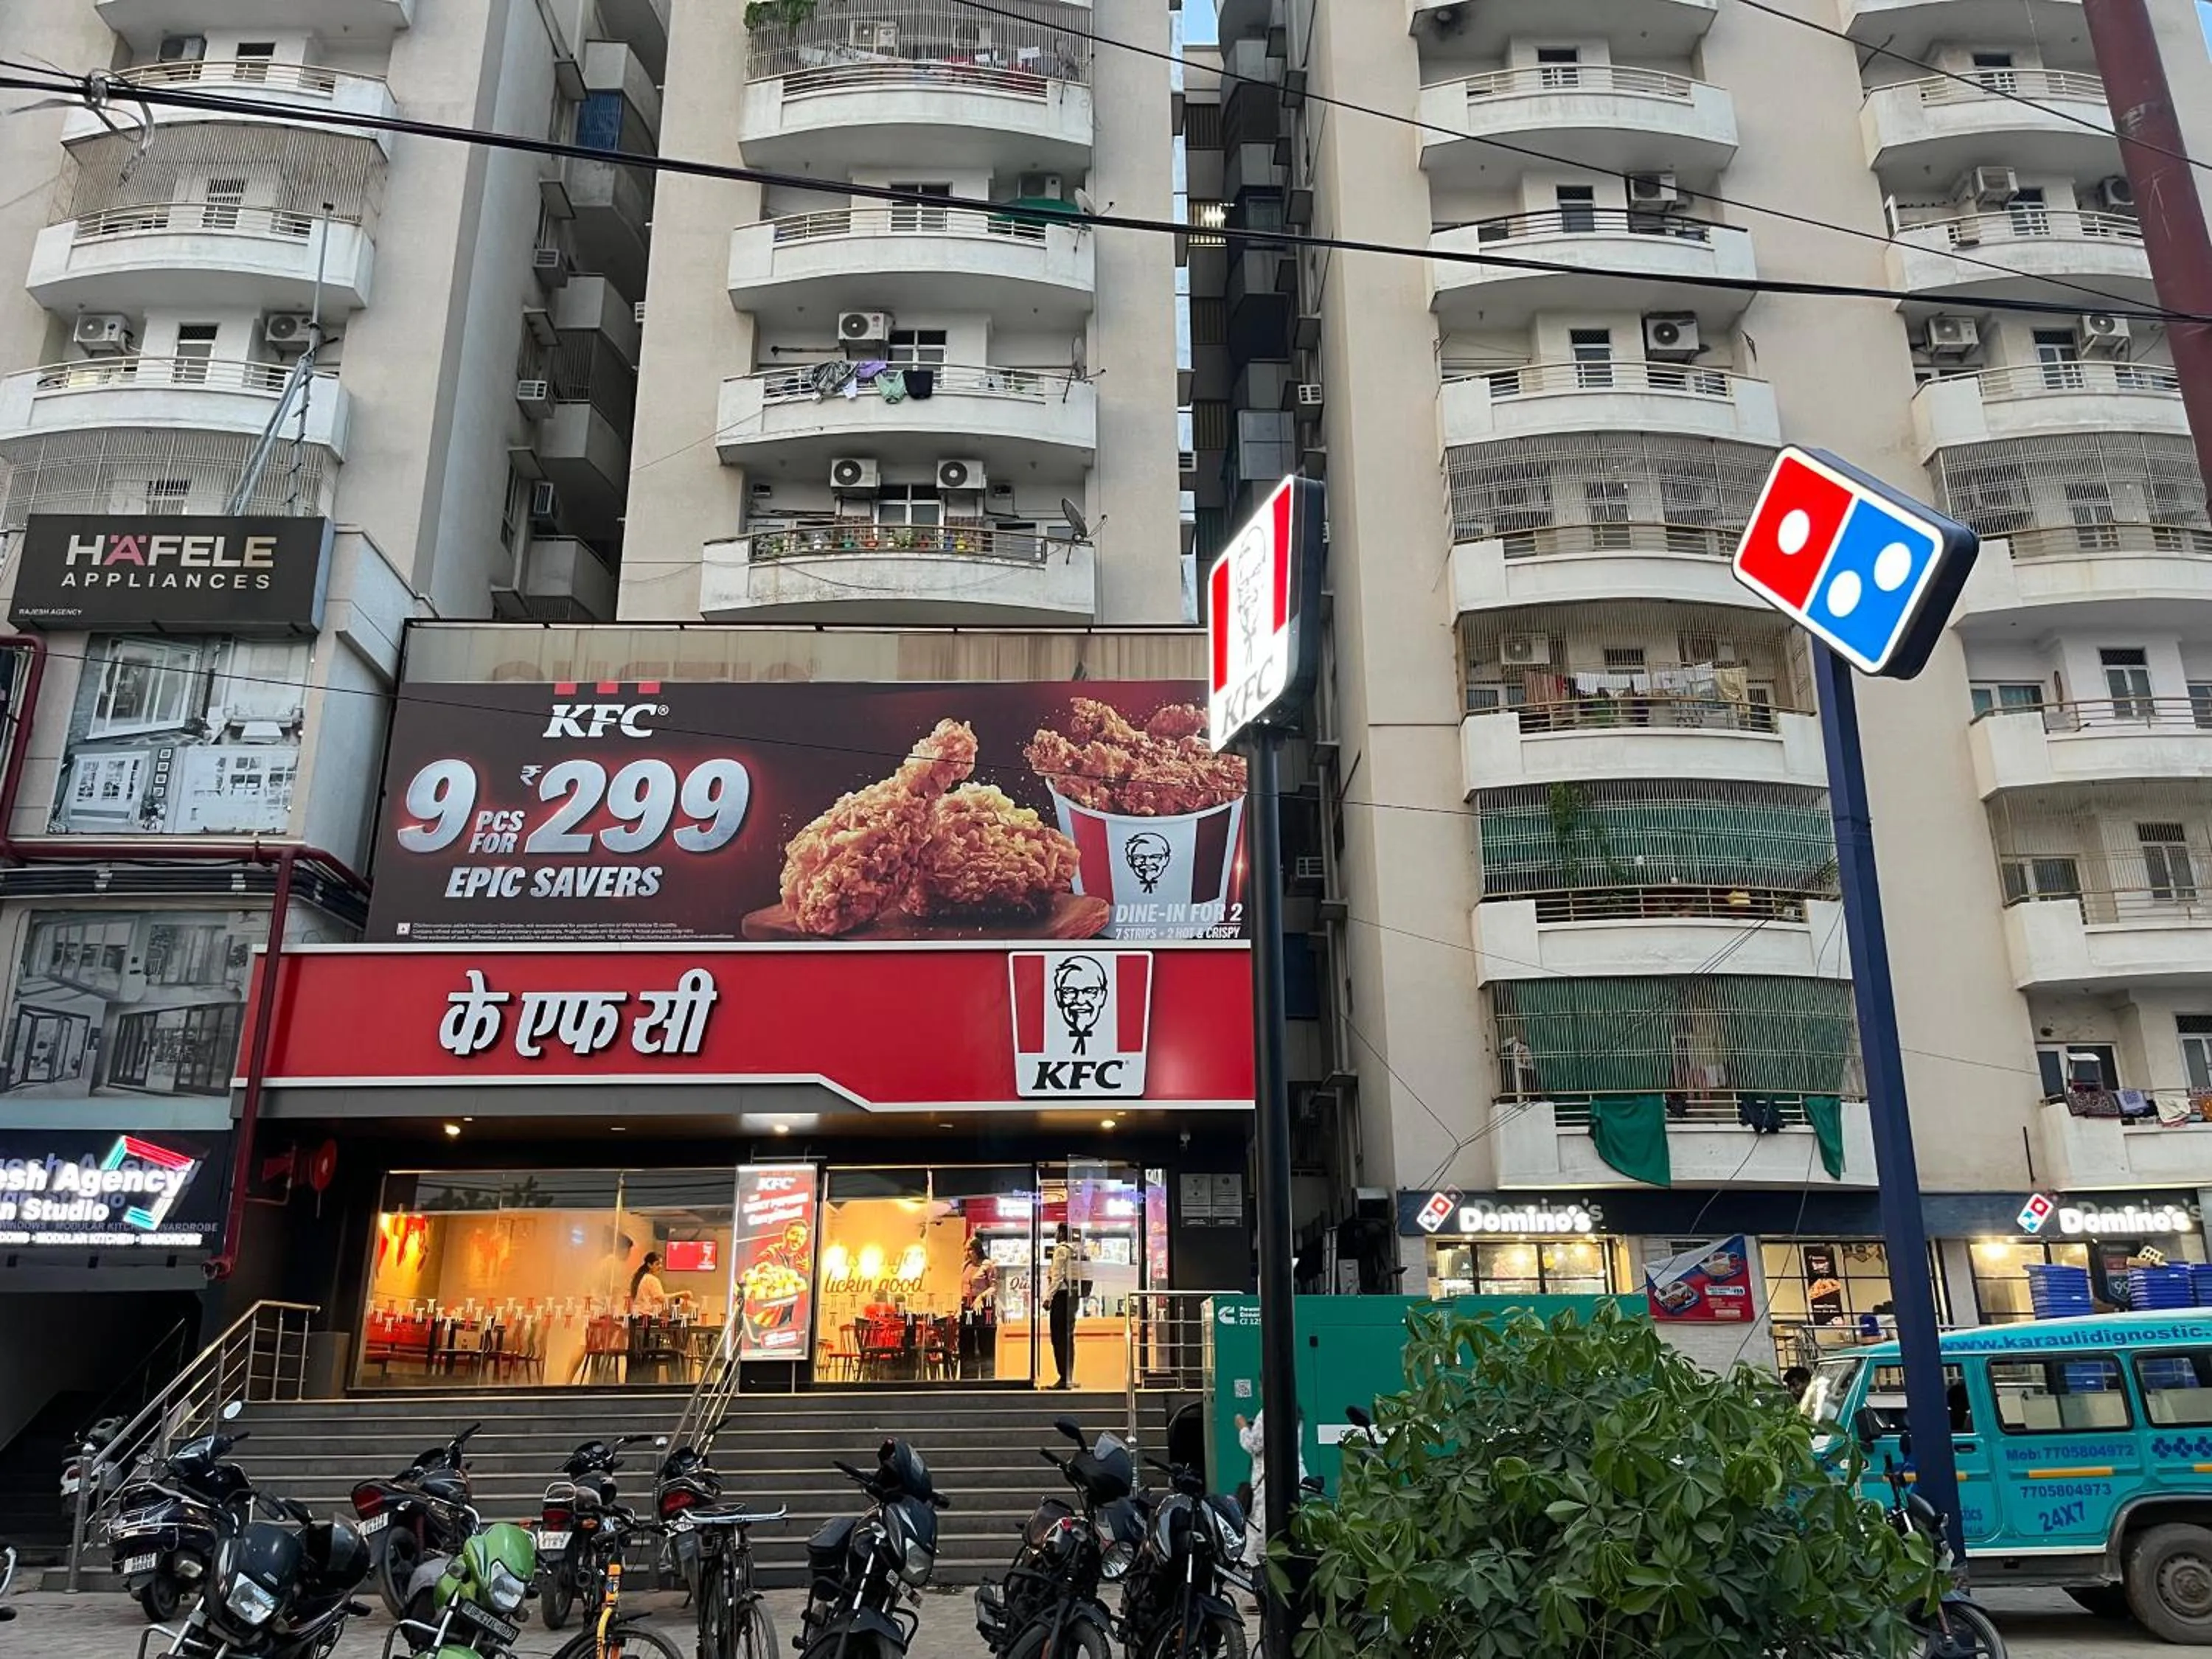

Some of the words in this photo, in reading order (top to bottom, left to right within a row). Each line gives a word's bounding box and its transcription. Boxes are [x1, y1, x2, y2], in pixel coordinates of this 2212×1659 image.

[66, 535, 277, 567] HÄFELE
[61, 573, 270, 589] APPLIANCES
[1221, 653, 1273, 738] KFC
[397, 759, 478, 853] 9
[475, 810, 525, 833] PCS
[468, 832, 518, 854] FOR
[445, 866, 523, 897] EPIC
[529, 866, 663, 897] SAVERS
[1115, 903, 1186, 922] DINE-IN
[1190, 903, 1225, 922] FOR
[1229, 902, 1243, 922] 2
[1124, 927, 1157, 939] STRIPS
[1206, 926, 1241, 939] CRISPY
[439, 970, 510, 1055] के
[515, 991, 628, 1057] एफ
[631, 968, 717, 1054] सी
[53, 1163, 189, 1198] Agency
[21, 1199, 109, 1221] Studio
[1459, 1205, 1593, 1233] Domino's
[2059, 1206, 2193, 1234] Domino's
[878, 1267, 926, 1293] good
[2020, 1483, 2112, 1498] 7705804973
[2039, 1500, 2087, 1533] 24X7
